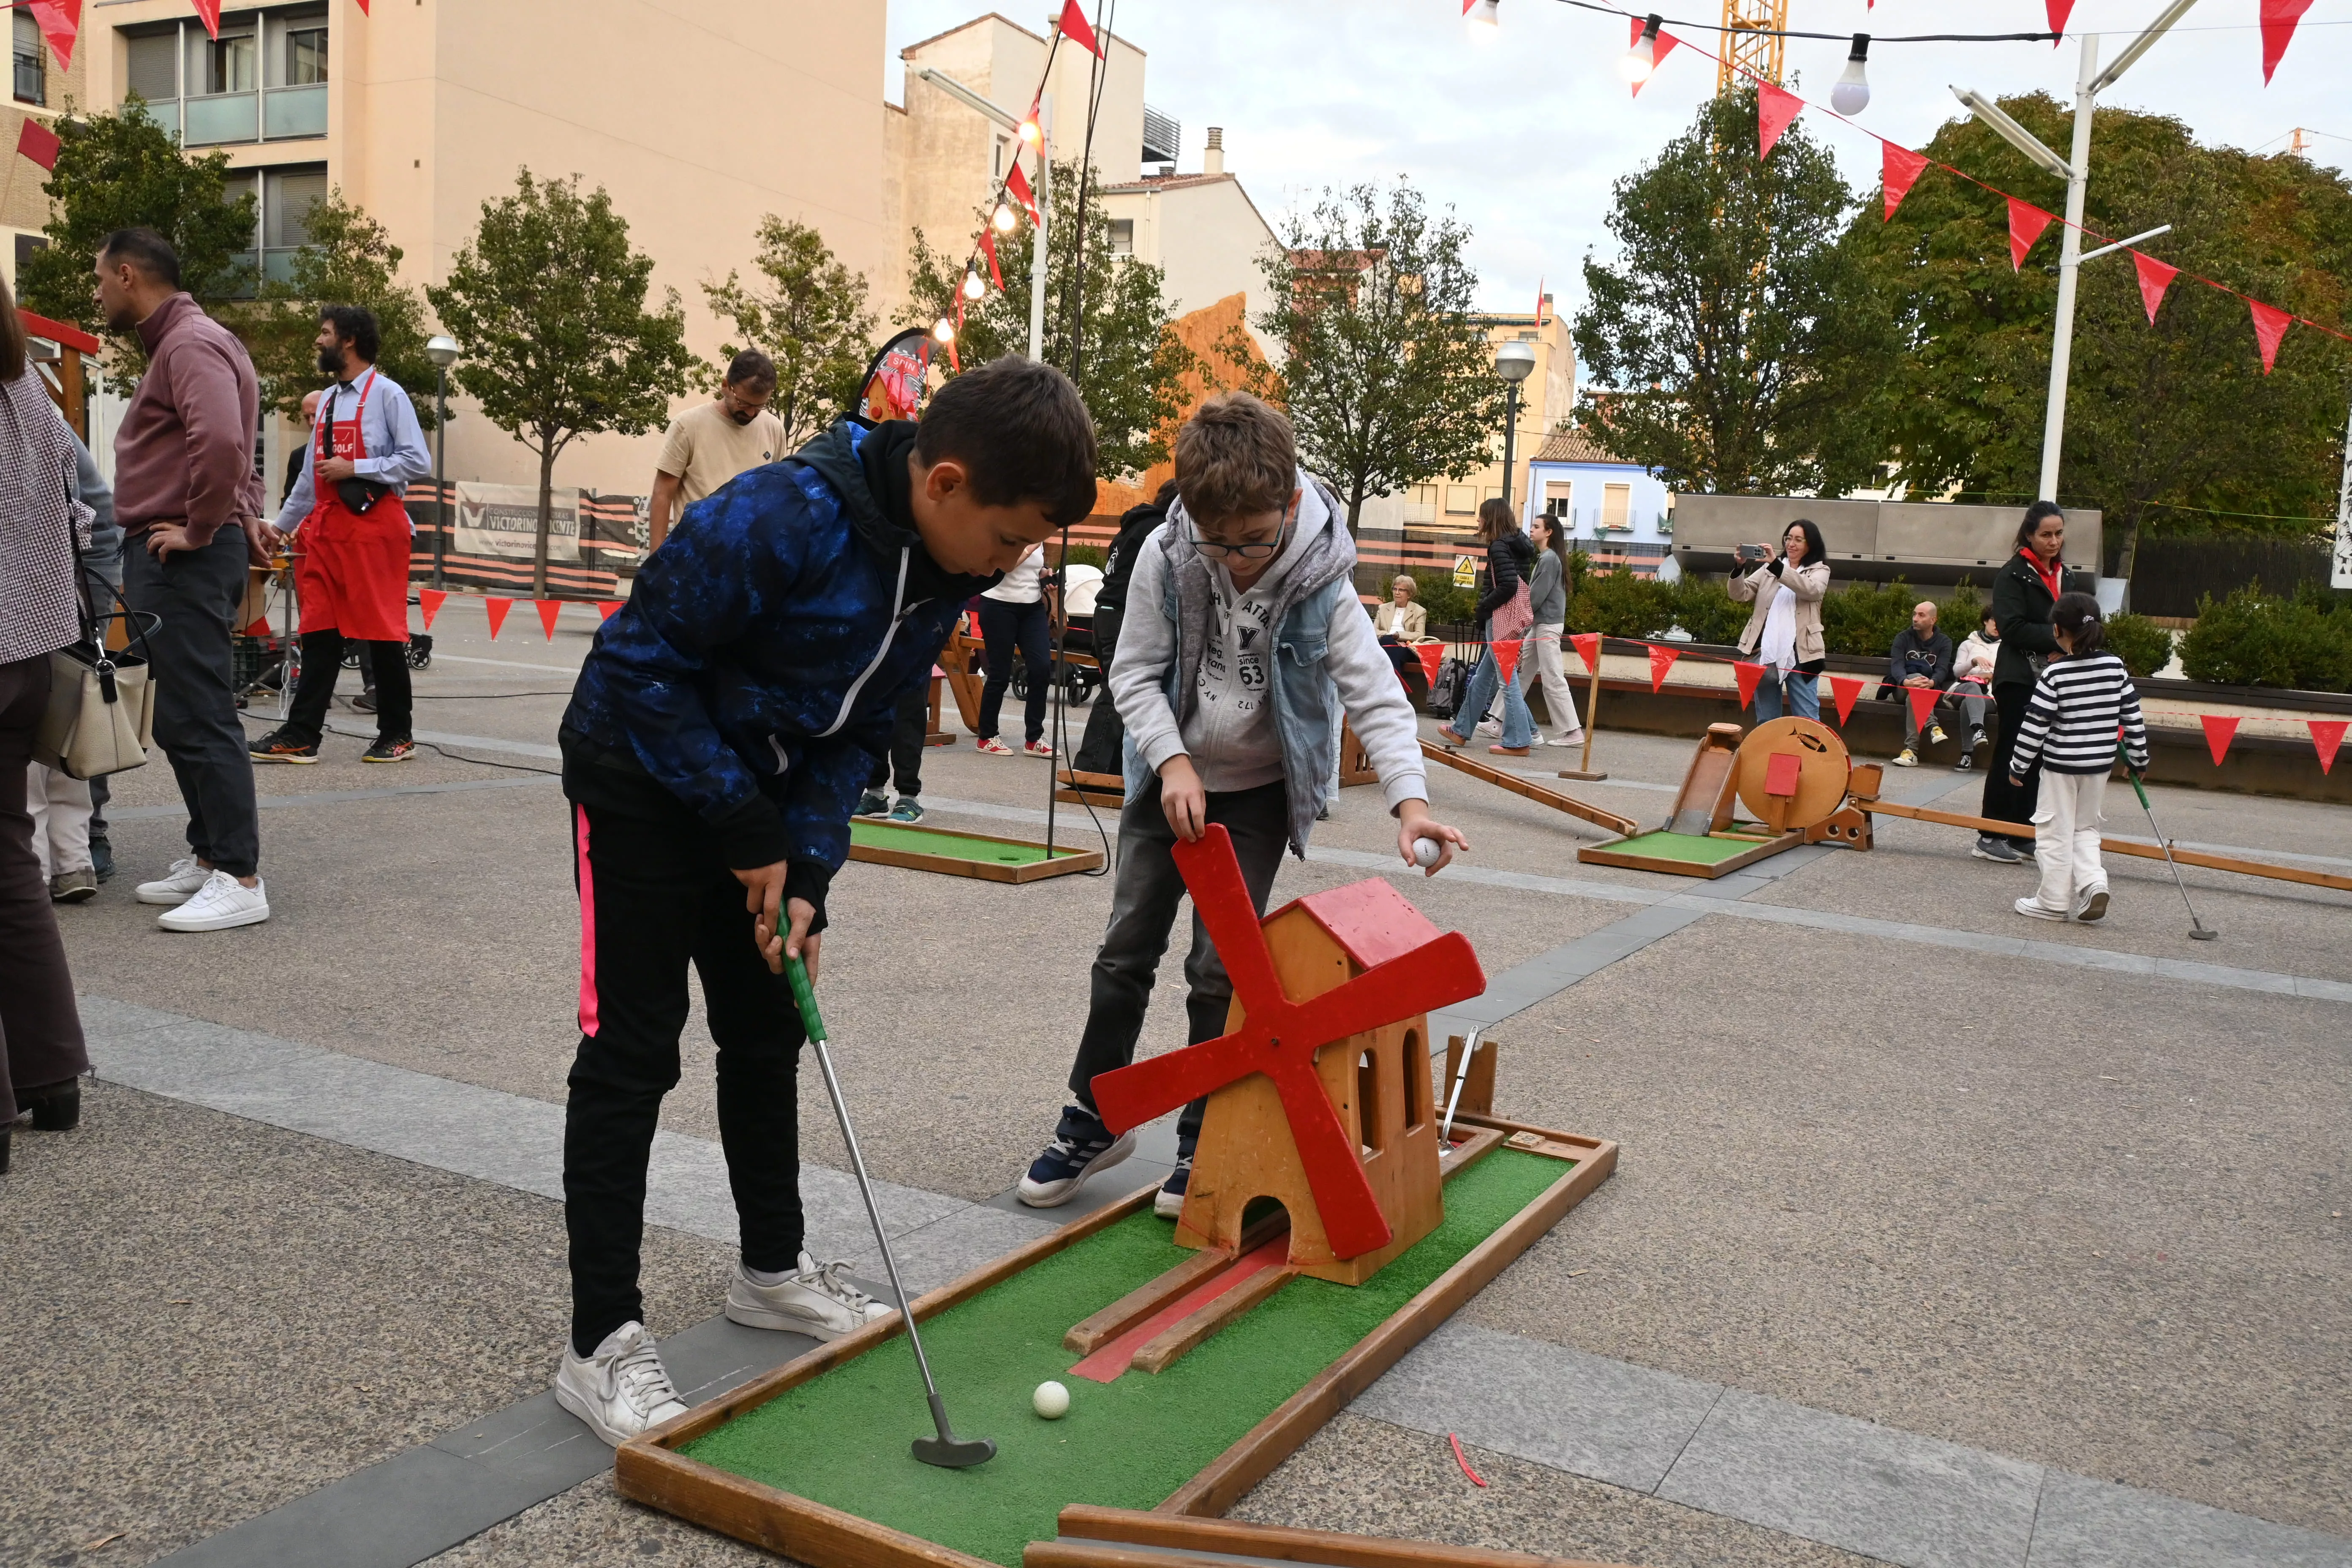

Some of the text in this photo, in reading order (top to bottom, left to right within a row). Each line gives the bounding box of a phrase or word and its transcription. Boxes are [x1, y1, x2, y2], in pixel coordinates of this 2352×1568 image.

[489, 515, 576, 536] VICTORINO ICENTE
[1239, 657, 1260, 665] since
[1239, 664, 1265, 686] 63
